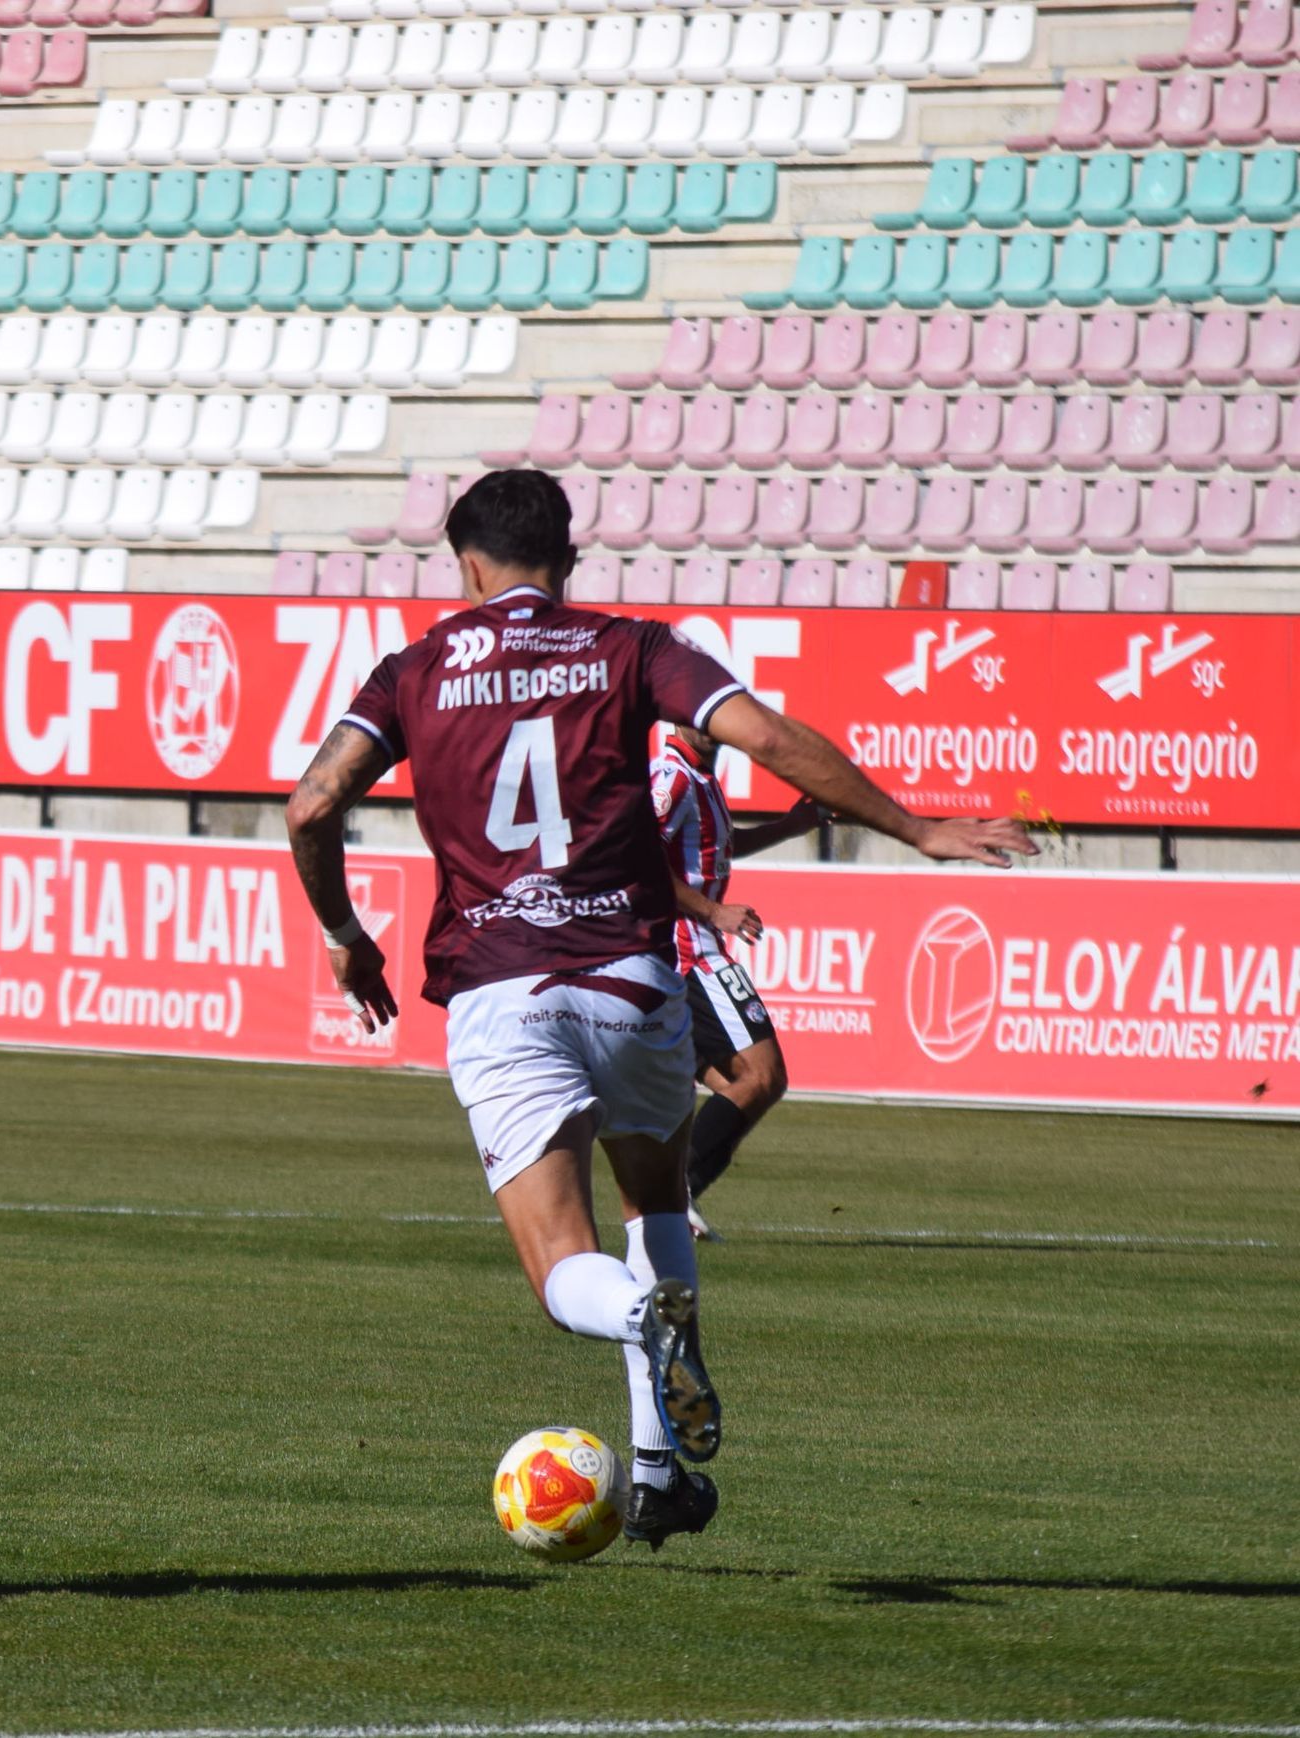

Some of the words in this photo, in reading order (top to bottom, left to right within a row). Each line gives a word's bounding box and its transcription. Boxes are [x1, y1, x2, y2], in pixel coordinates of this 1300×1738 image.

[4, 600, 132, 776] CF
[437, 670, 503, 710] MIKI
[509, 659, 609, 703] BOSCH
[972, 655, 1007, 692] sgc
[1191, 659, 1226, 698] sgc
[847, 713, 1038, 787] sangregorio
[1060, 718, 1258, 793] sangregorio
[485, 715, 574, 869] 4
[3, 854, 56, 953] DE
[70, 858, 142, 960] LA
[144, 863, 286, 968] PLATA
[58, 967, 243, 1038] (Zamora)
[1000, 938, 1142, 1012] ELOY
[794, 1008, 872, 1035] ZAMORA
[994, 1014, 1222, 1061] CONTRUCCIONES
